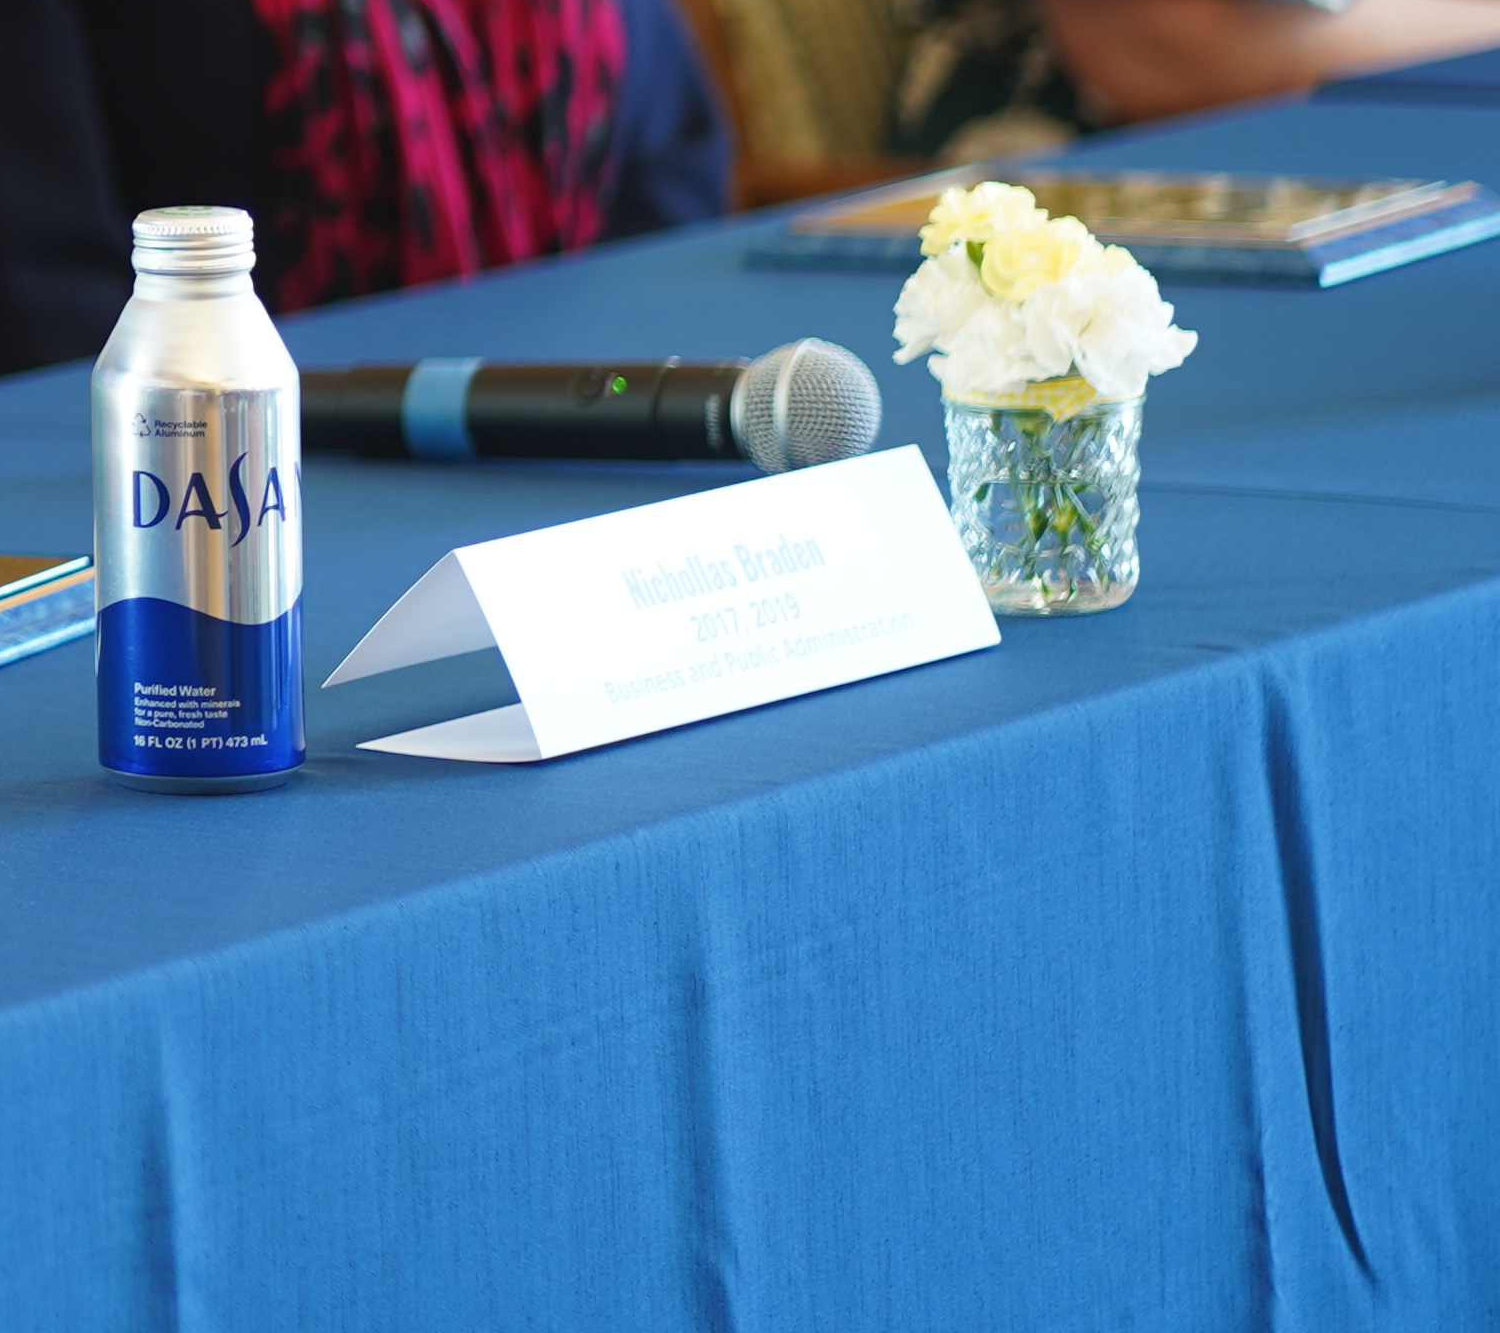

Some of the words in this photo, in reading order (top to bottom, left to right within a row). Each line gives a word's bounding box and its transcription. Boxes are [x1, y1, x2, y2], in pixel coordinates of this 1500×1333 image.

[154, 419, 208, 430] Recyclable
[154, 429, 205, 438] Aluminum
[621, 553, 740, 610] Nichollas
[733, 534, 827, 583] Braden
[688, 605, 752, 643] 2017,
[748, 592, 801, 629] 2019
[604, 667, 687, 705] Business
[689, 654, 724, 685] and
[723, 642, 782, 674] Public
[782, 611, 916, 660] Administration
[134, 682, 177, 697] Purified
[179, 685, 216, 697] Water
[134, 697, 177, 709] Enhanced
[178, 699, 199, 709] with
[200, 699, 241, 709] minerals
[134, 708, 146, 717] for
[154, 710, 177, 720] pure,
[178, 710, 203, 719] fresh
[204, 710, 229, 719] taste
[134, 717, 205, 729] Non-Carbonated
[133, 735, 146, 747] 16
[148, 736, 162, 748] FL
[164, 736, 184, 749] OZ
[186, 736, 197, 750] (1
[201, 736, 223, 749] PT)
[226, 736, 248, 747] 473
[250, 734, 268, 746] mL
